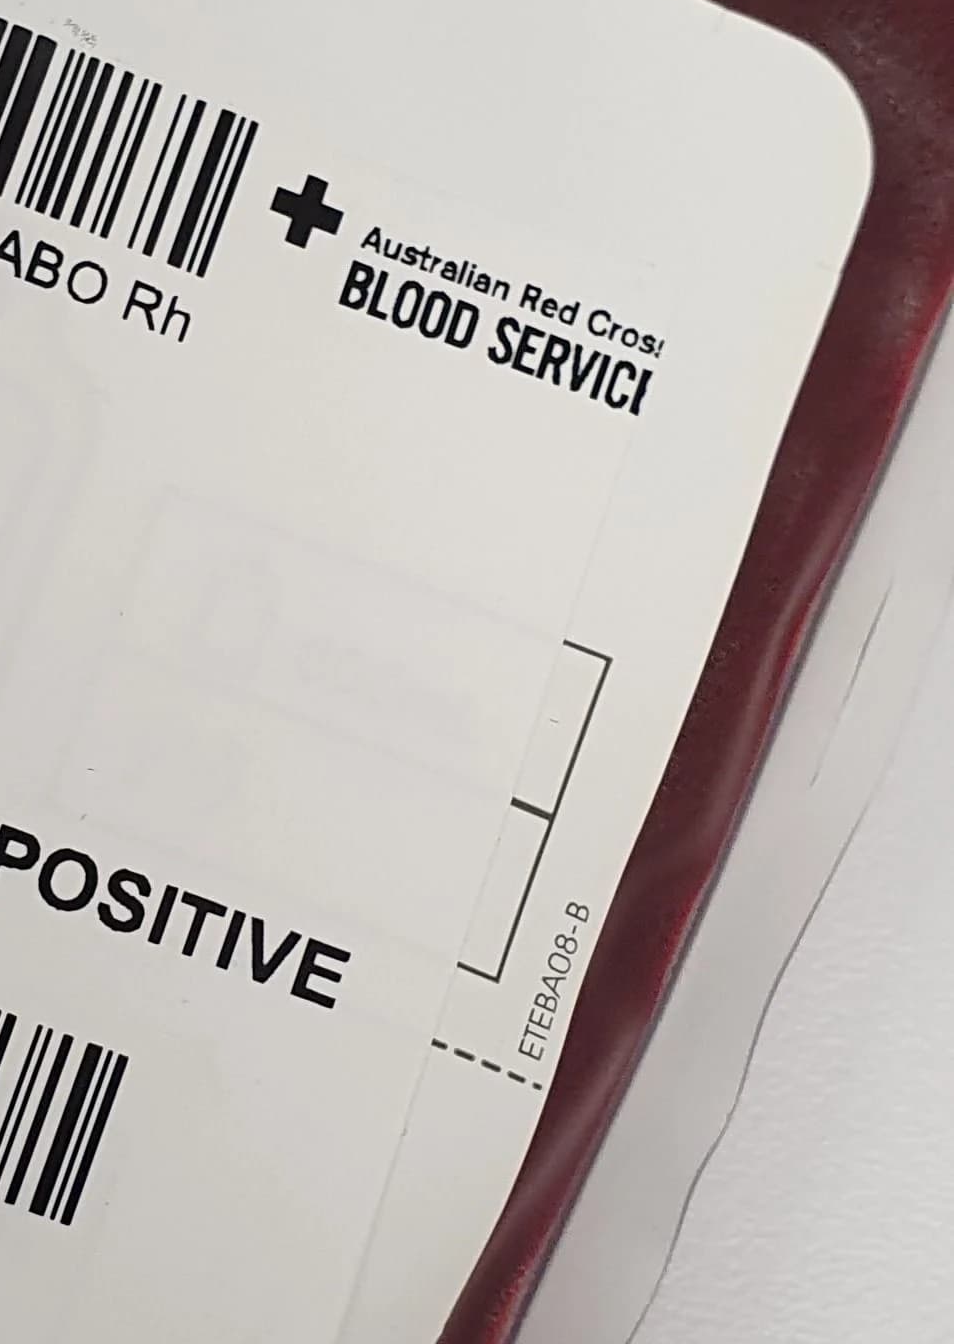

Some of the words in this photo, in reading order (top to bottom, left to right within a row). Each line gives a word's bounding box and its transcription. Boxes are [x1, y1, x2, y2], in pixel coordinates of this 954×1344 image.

[122, 281, 192, 342] Rh
[338, 260, 480, 349] BLOOD
[360, 227, 510, 301] Australian
[519, 284, 581, 327] Red
[518, 901, 591, 1062] ETEBA08-B
